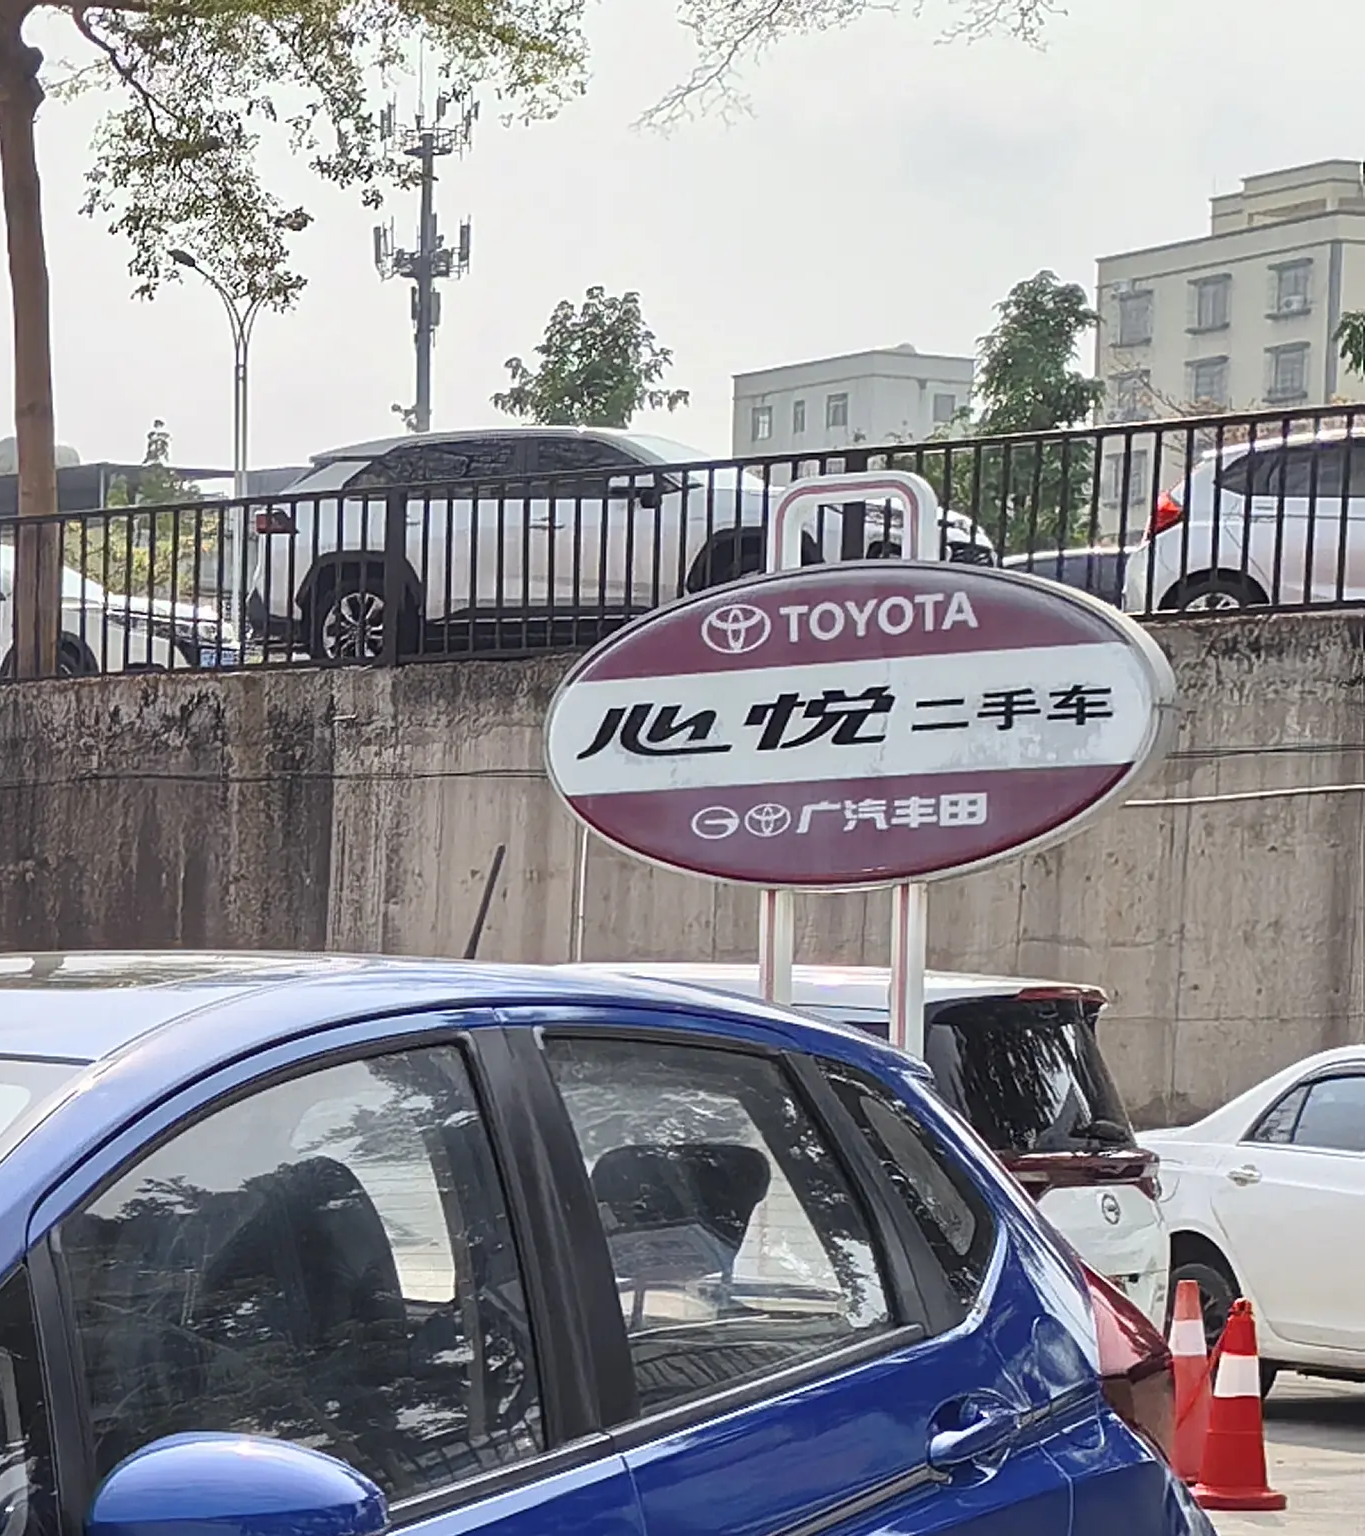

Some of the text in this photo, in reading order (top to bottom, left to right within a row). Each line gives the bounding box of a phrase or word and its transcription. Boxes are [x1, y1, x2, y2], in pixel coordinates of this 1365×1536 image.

[779, 591, 978, 643] TOYOTA
[576, 685, 1115, 761] 心悦二手车
[796, 792, 988, 834] 广汽丰田
